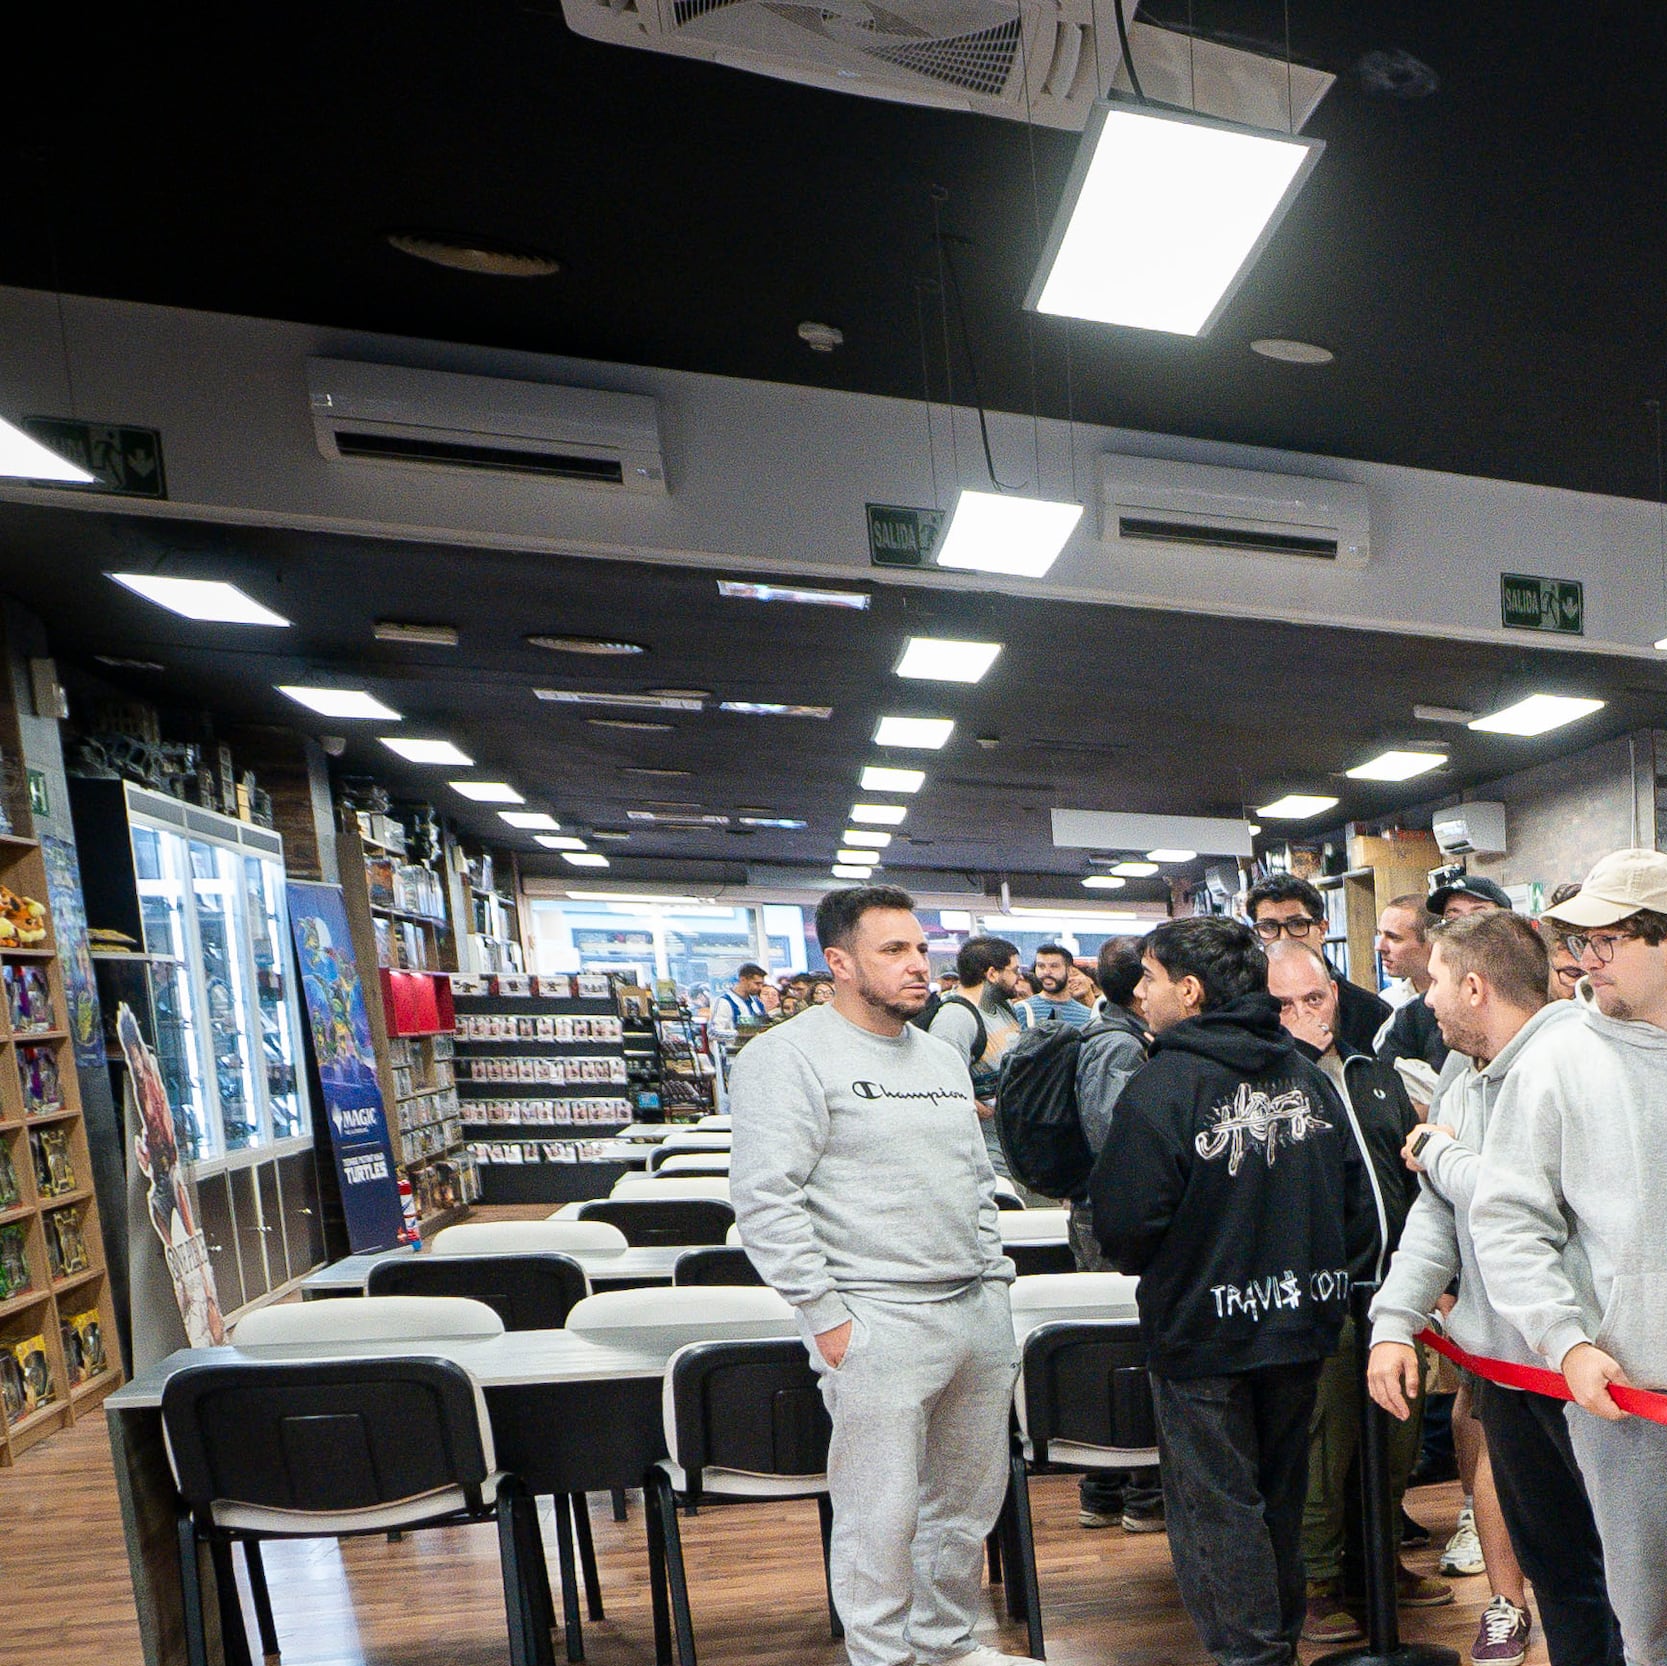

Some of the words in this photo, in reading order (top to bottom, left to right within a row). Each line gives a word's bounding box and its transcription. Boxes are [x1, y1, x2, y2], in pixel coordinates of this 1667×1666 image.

[873, 519, 919, 549] SALIDA
[1505, 587, 1540, 615] SALIDA
[851, 1079, 969, 1107] Champion
[342, 1107, 378, 1127] MAGIC
[343, 1158, 389, 1185] TURTLES
